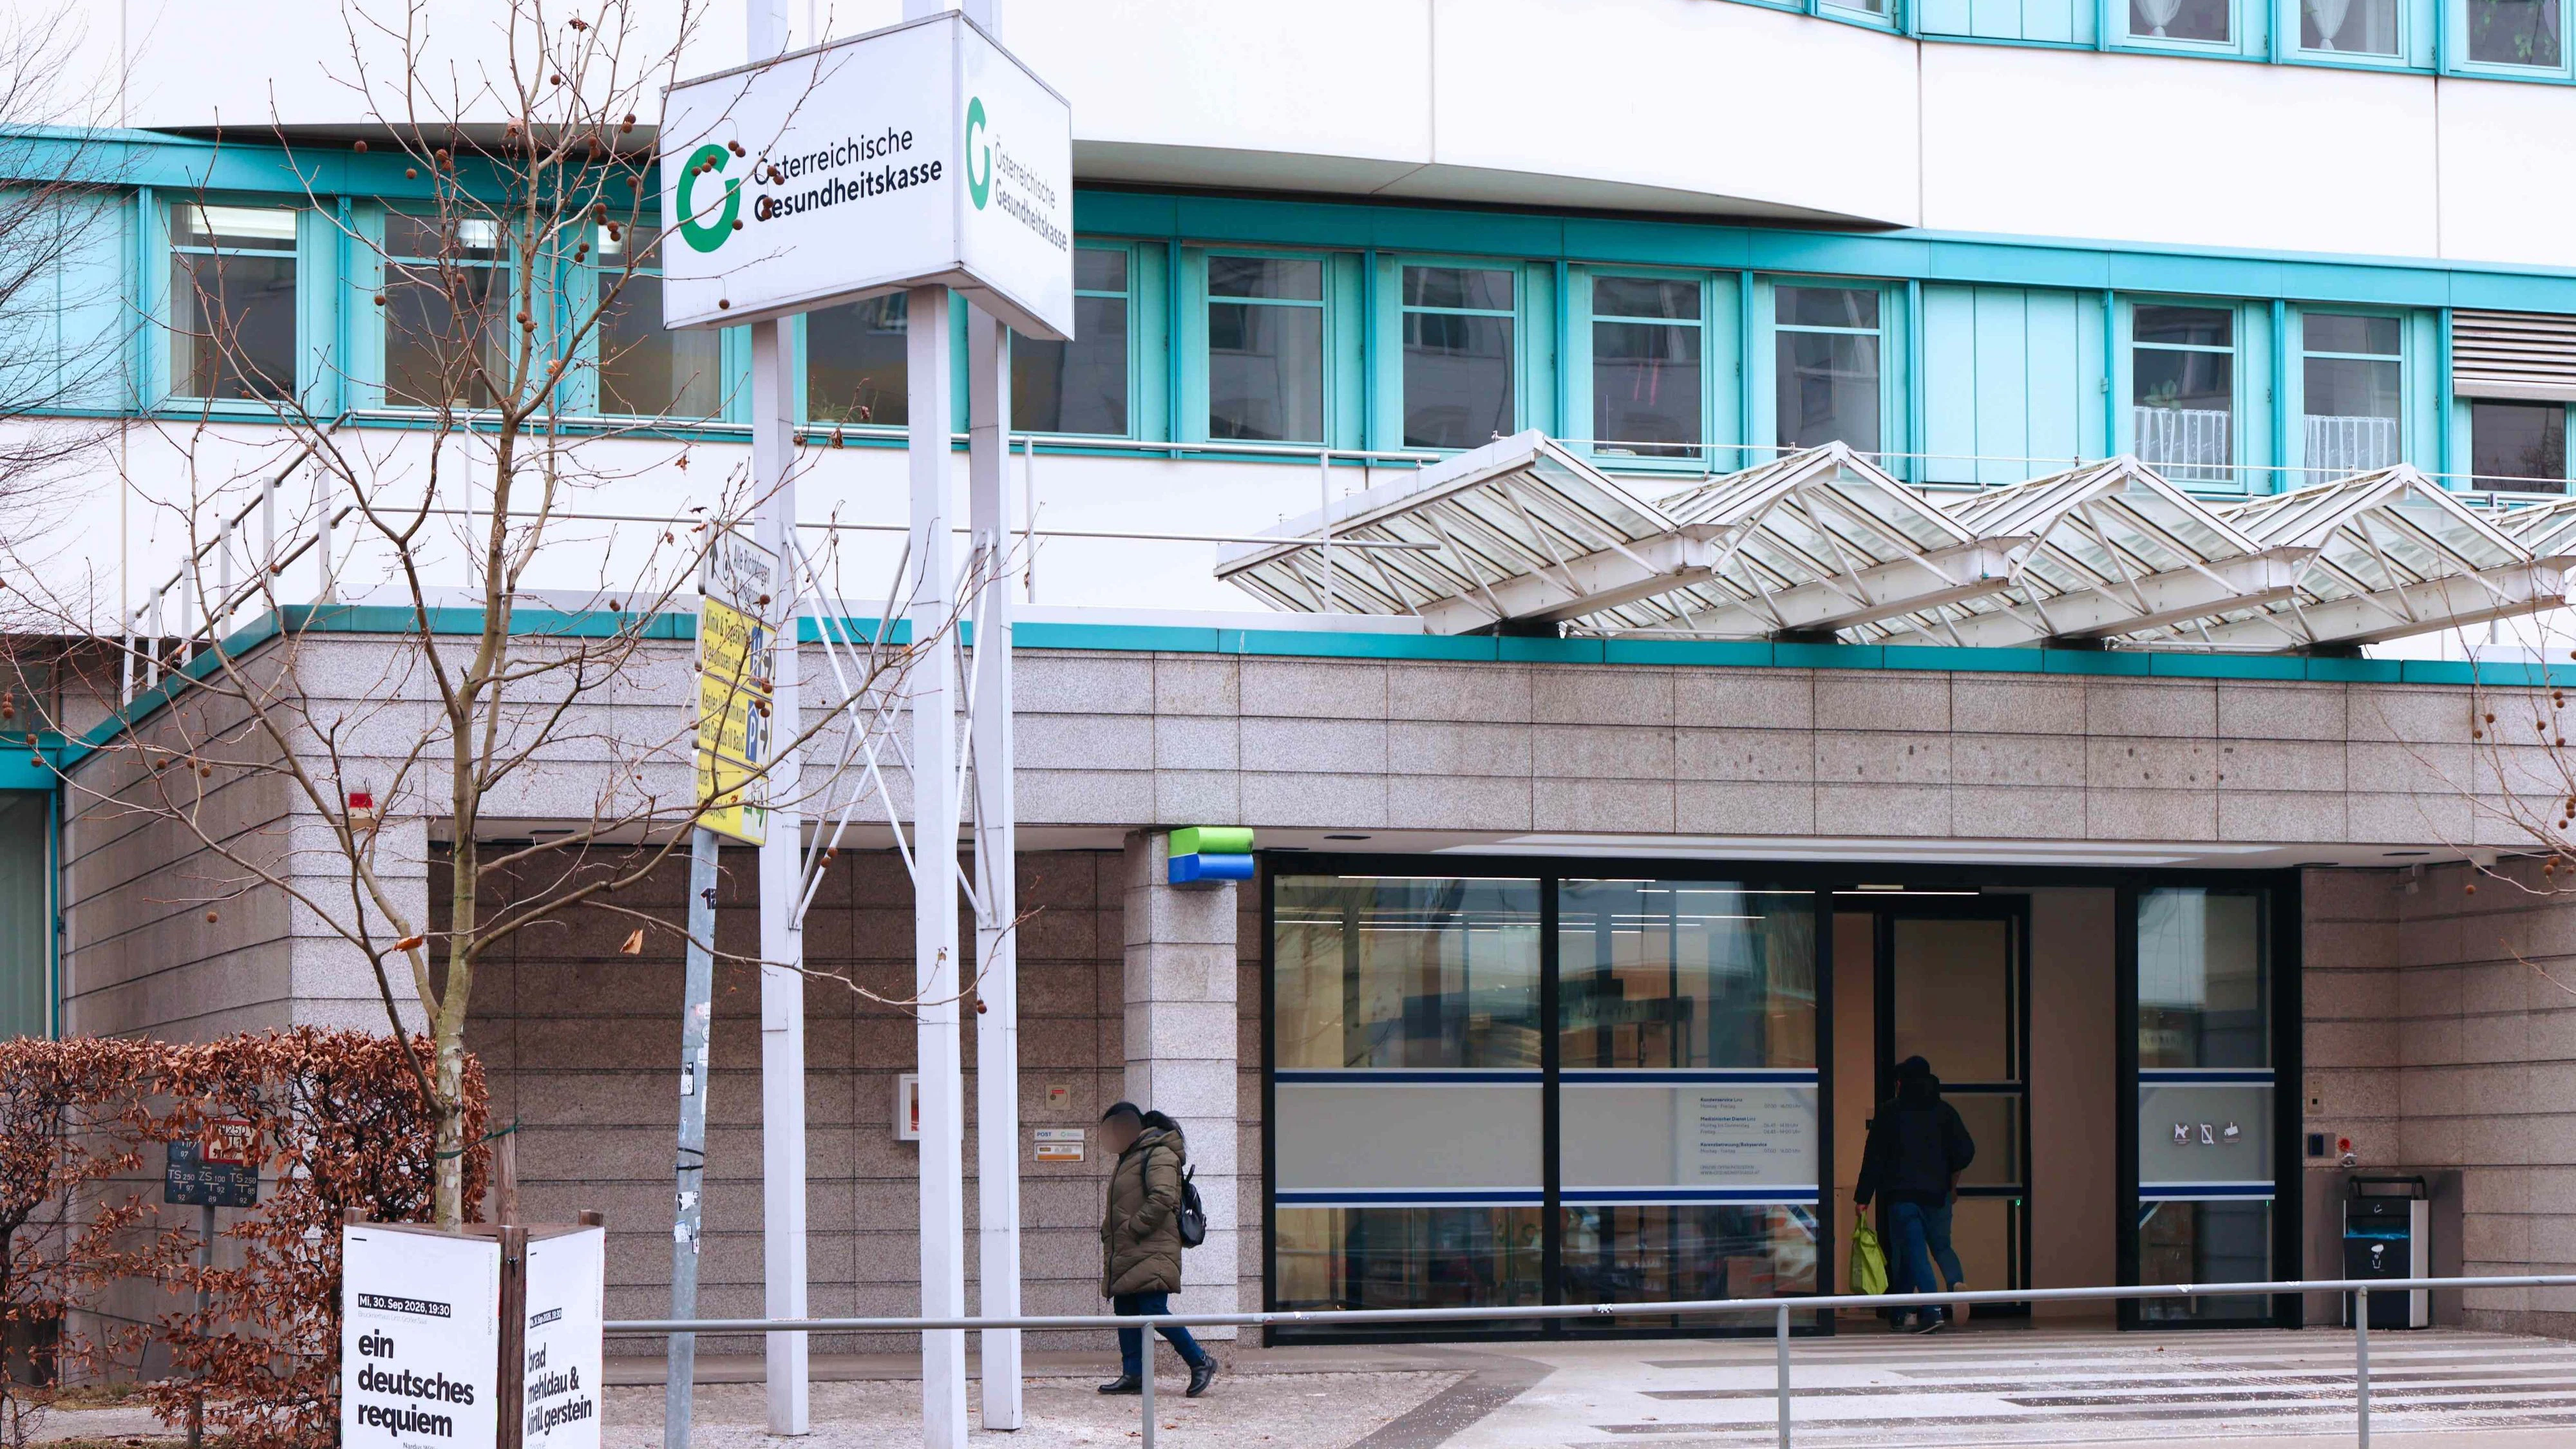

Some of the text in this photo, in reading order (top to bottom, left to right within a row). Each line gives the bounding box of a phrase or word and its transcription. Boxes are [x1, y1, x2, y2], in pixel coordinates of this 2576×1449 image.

[995, 133, 1056, 210] Österreichische
[754, 160, 942, 222] Gesundheitskasse
[995, 178, 1067, 252] Gesundheitskasse
[733, 544, 770, 587] Alle Richtungen
[705, 607, 748, 648] Klinik & Tagesklin
[732, 653, 742, 676] Lin
[702, 687, 746, 725] Kepler Unilinikum
[700, 719, 710, 740] Med
[168, 1170, 182, 1180] TS
[198, 1171, 213, 1181] ZS
[230, 1173, 243, 1183] TS
[359, 1295, 450, 1316] Mi, 30. Sep 2026, 19:30
[358, 1329, 394, 1359] ein
[528, 1341, 546, 1374] brad
[358, 1363, 474, 1405] deutsches
[527, 1366, 580, 1405] mehldau &
[357, 1404, 453, 1437] requiem
[527, 1394, 592, 1437] kirill gerstein
